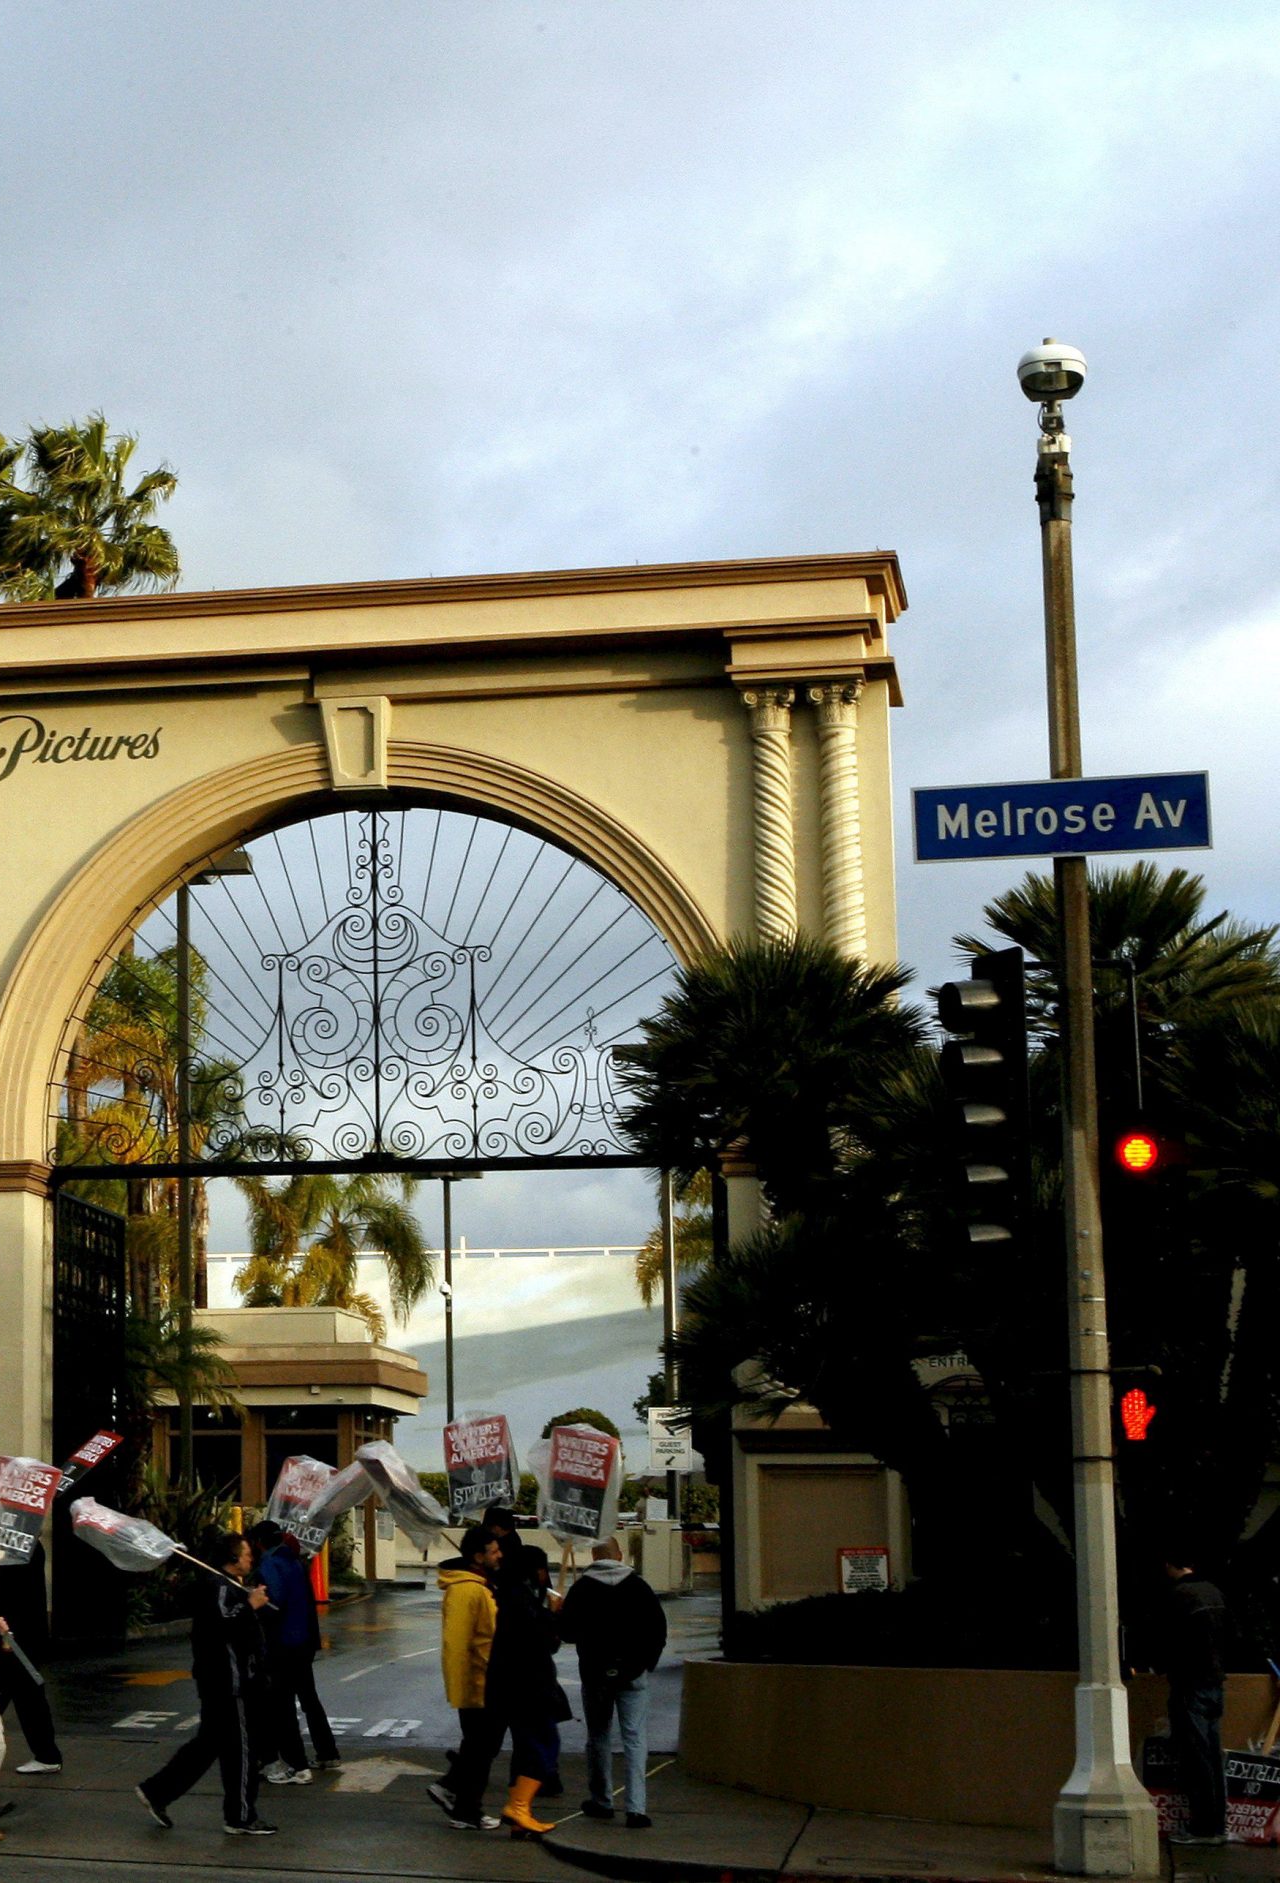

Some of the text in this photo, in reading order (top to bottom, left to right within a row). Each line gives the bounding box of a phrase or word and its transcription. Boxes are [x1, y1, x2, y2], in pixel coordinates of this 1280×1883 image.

[937, 792, 1186, 840] Melrose Av
[929, 1356, 966, 1368] ENTR
[558, 1433, 609, 1455] WRITERS
[559, 1447, 593, 1465] GUILD
[556, 1461, 605, 1481] AMERICA
[33, 1487, 48, 1496] OF
[1225, 1760, 1280, 1784] TRIKE
